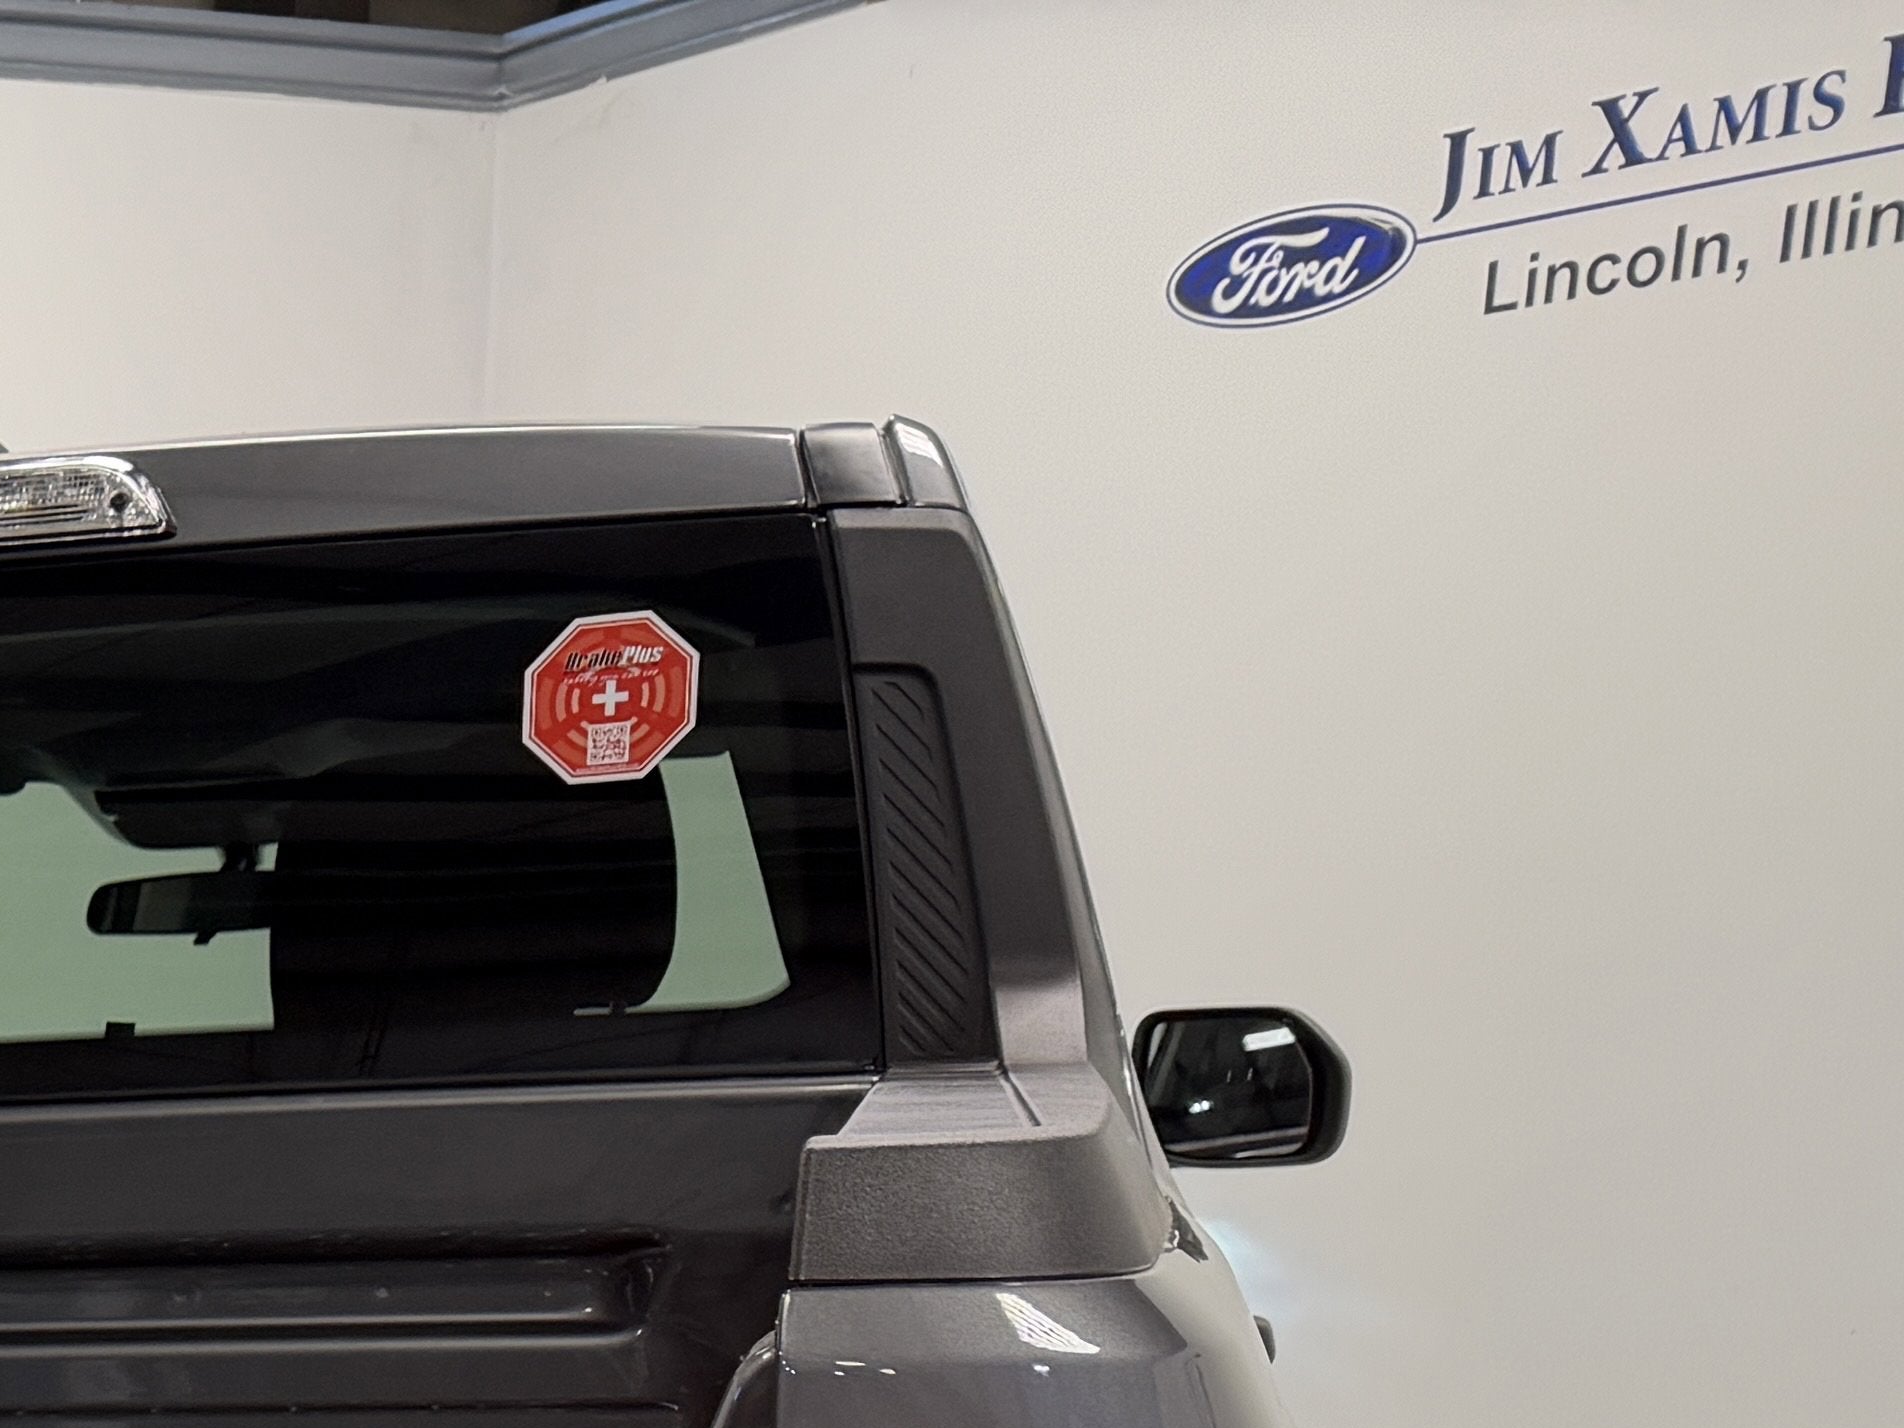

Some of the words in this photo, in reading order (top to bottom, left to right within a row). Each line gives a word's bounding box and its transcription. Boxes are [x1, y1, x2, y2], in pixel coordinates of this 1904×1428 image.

[1433, 128, 1563, 222] JIM
[1581, 70, 1846, 178] XAMIS
[1212, 228, 1365, 313] Ford
[1484, 224, 1748, 315] Lincoln,
